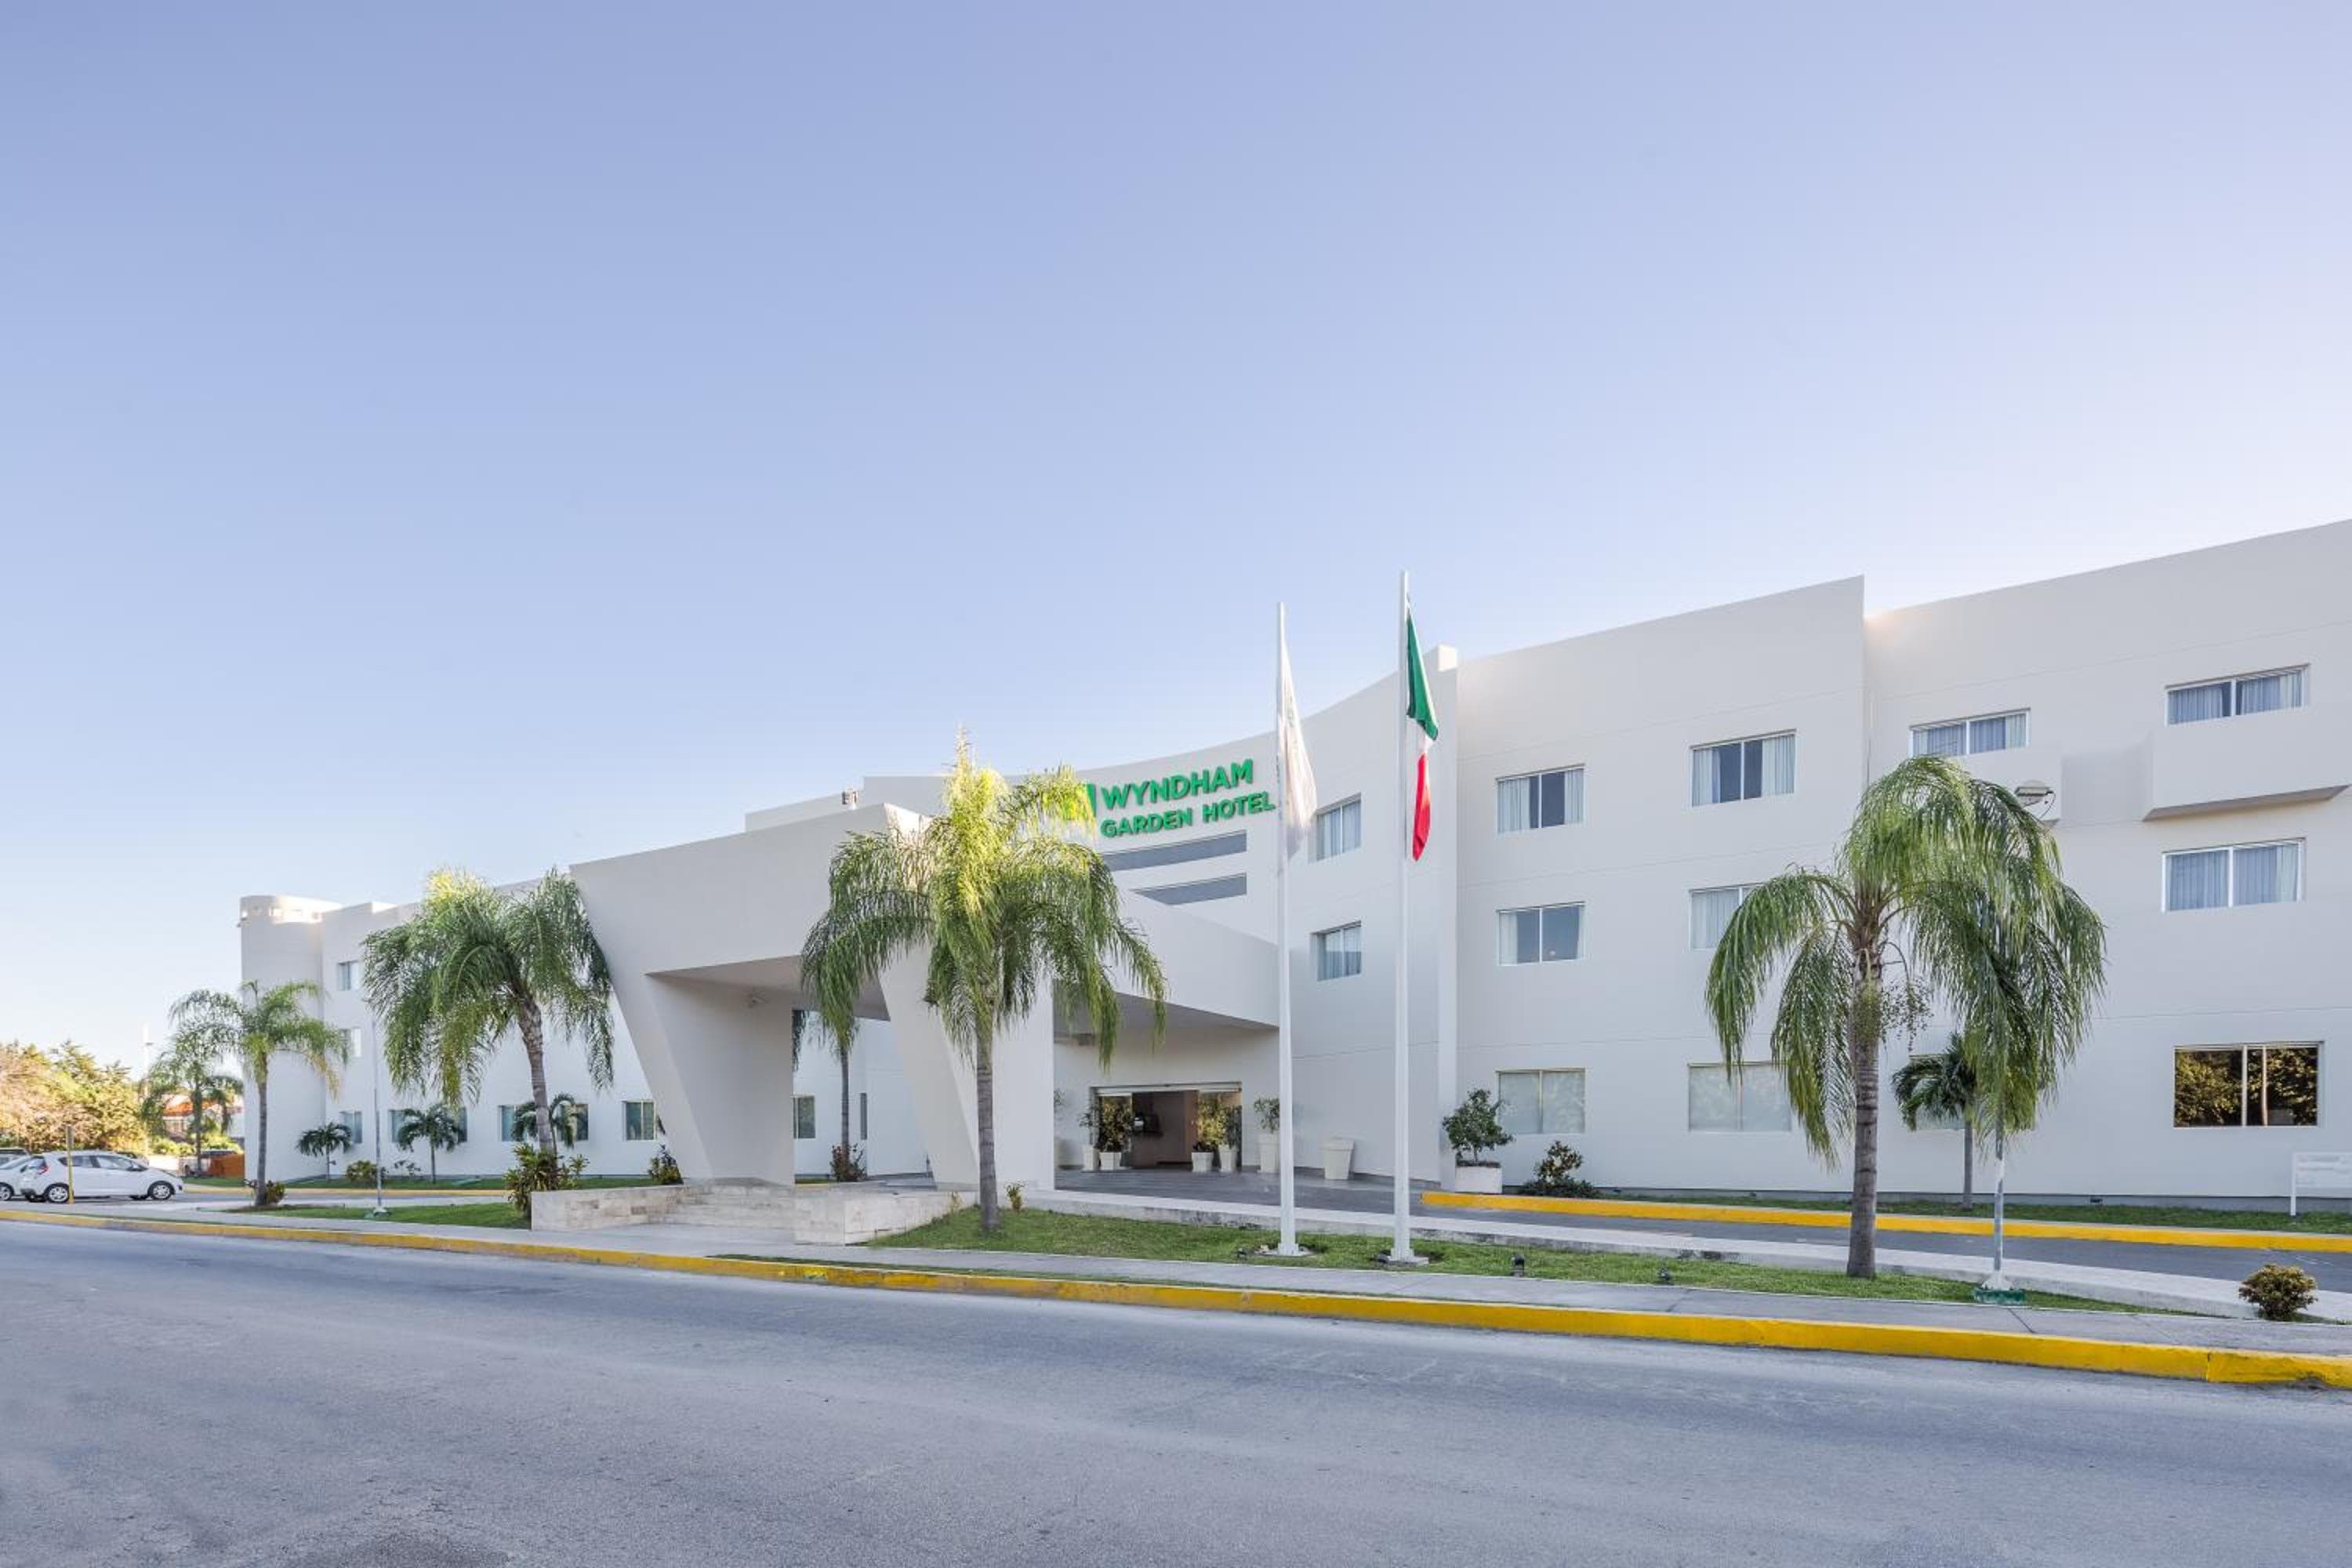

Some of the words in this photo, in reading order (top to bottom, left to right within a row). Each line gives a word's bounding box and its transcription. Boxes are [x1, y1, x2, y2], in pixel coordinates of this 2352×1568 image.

[1101, 758, 1254, 810] WYNDHAM
[1100, 808, 1193, 837] GARDEN
[1201, 791, 1275, 822] HOTEL
